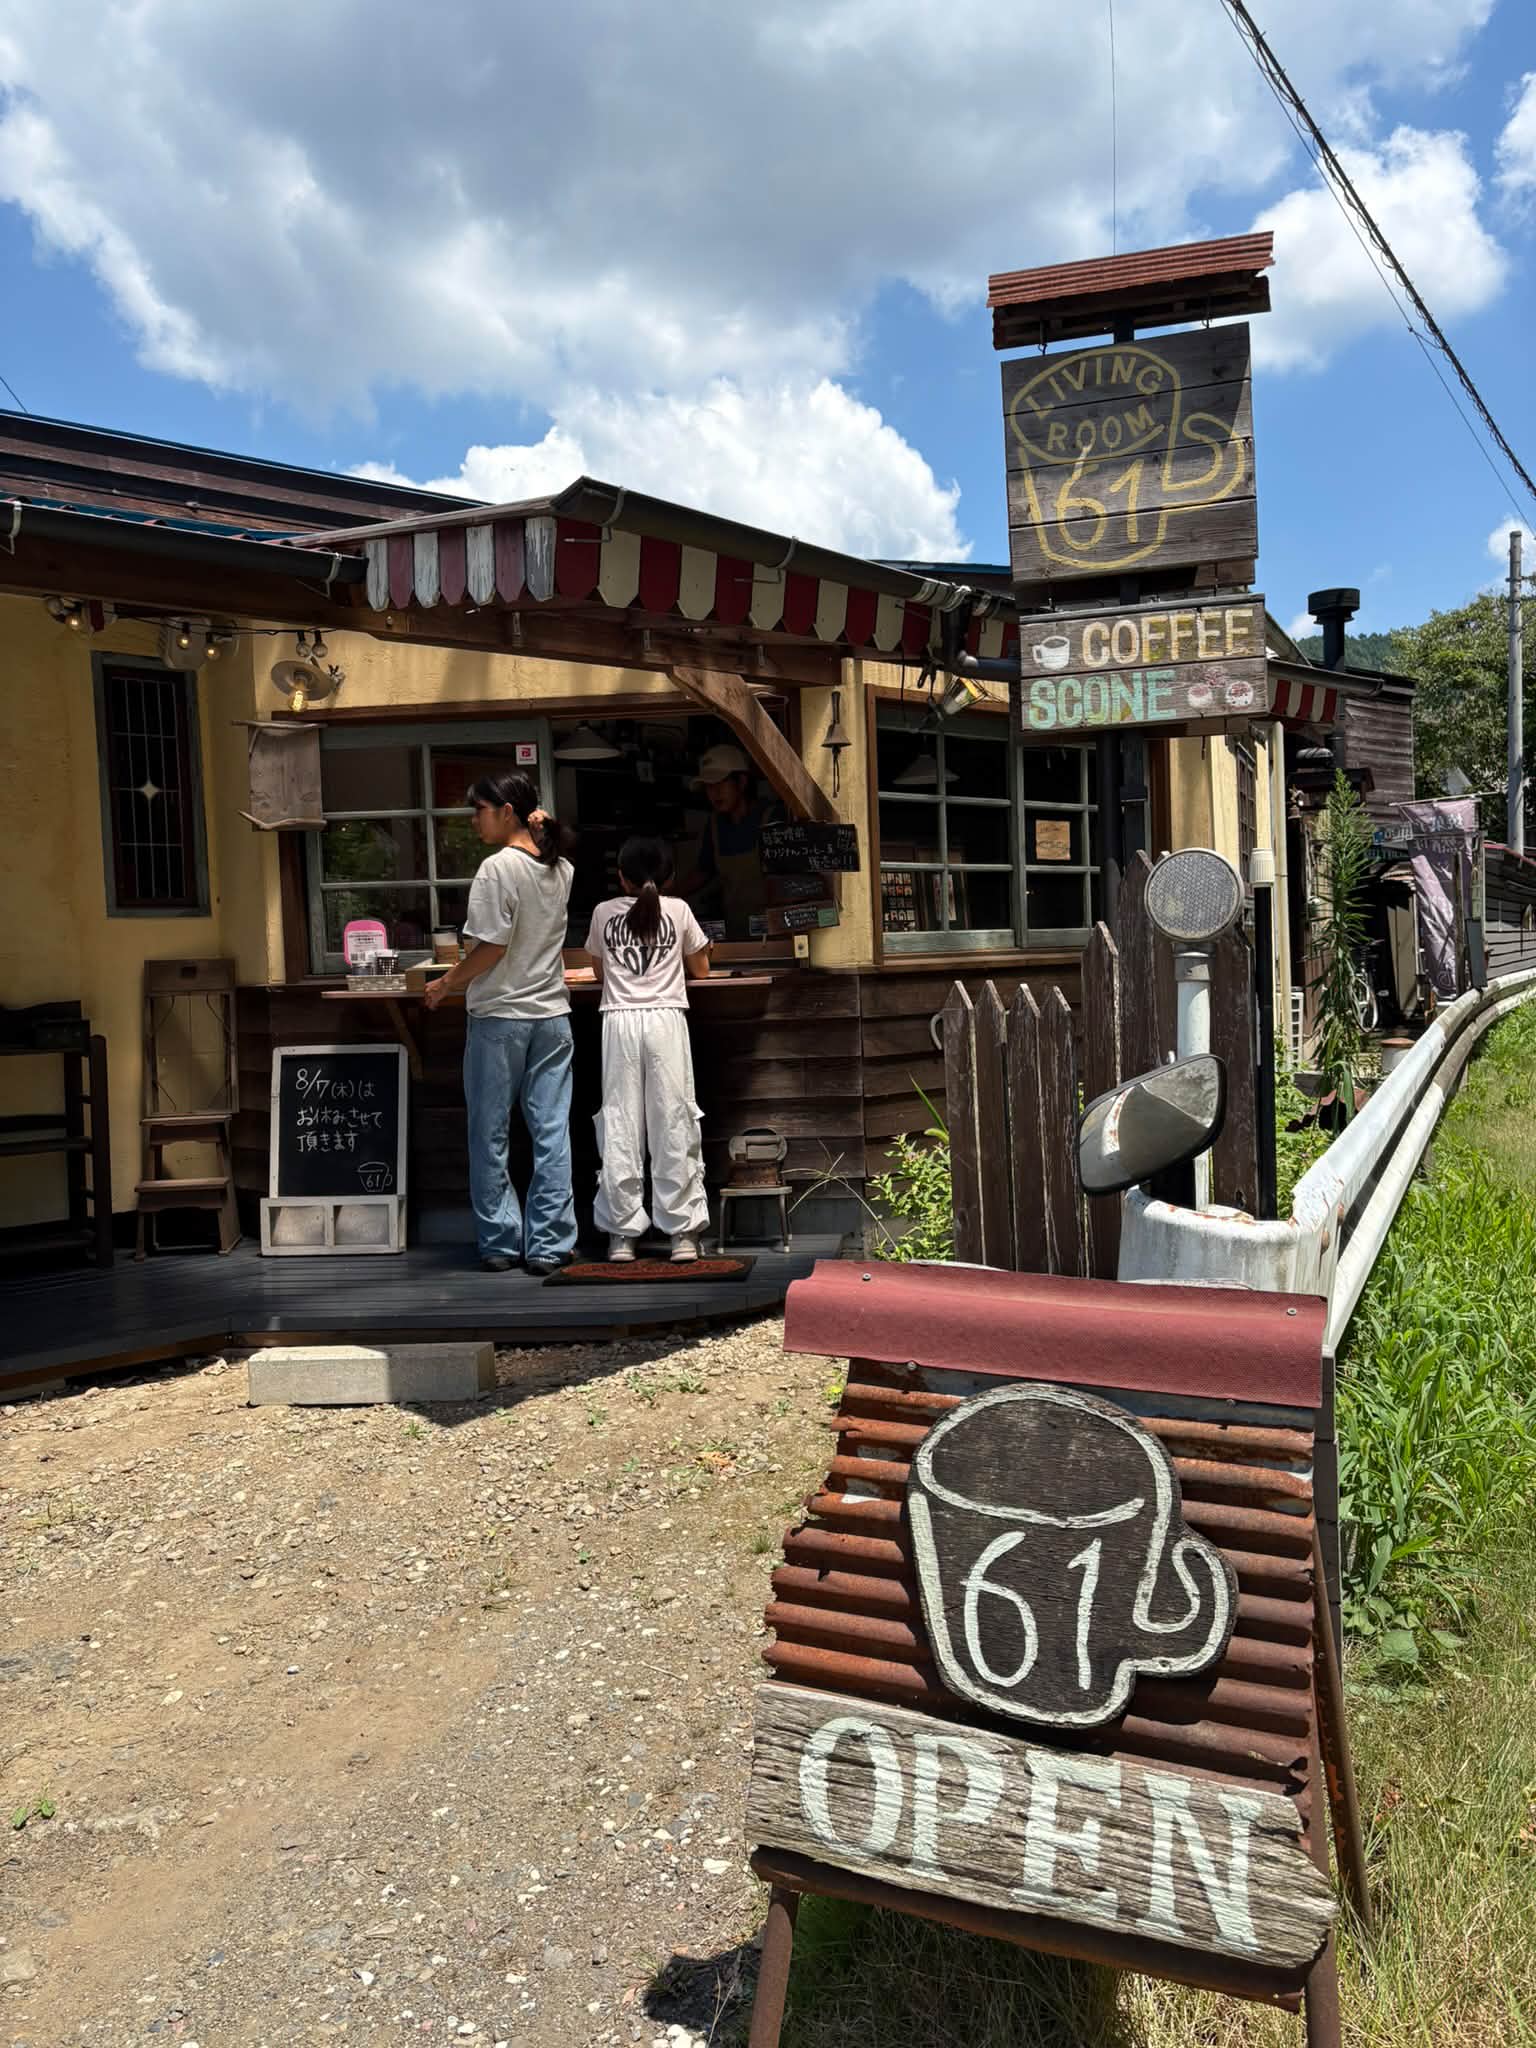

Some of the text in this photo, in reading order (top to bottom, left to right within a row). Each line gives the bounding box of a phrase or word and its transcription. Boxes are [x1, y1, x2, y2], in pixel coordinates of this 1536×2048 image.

[1025, 355, 1163, 419] LIVING
[1047, 403, 1156, 451] ROOM
[1056, 444, 1145, 550] 61
[1082, 608, 1254, 668] COFFEE
[1029, 669, 1177, 730] SCONE
[607, 945, 673, 976] LOVE
[296, 1106, 384, 1129] お休みさせて
[296, 1131, 360, 1153] 頂きます
[366, 1174, 380, 1188] 61
[960, 1530, 1103, 1690] 61
[798, 1716, 1264, 1953] OPEN
